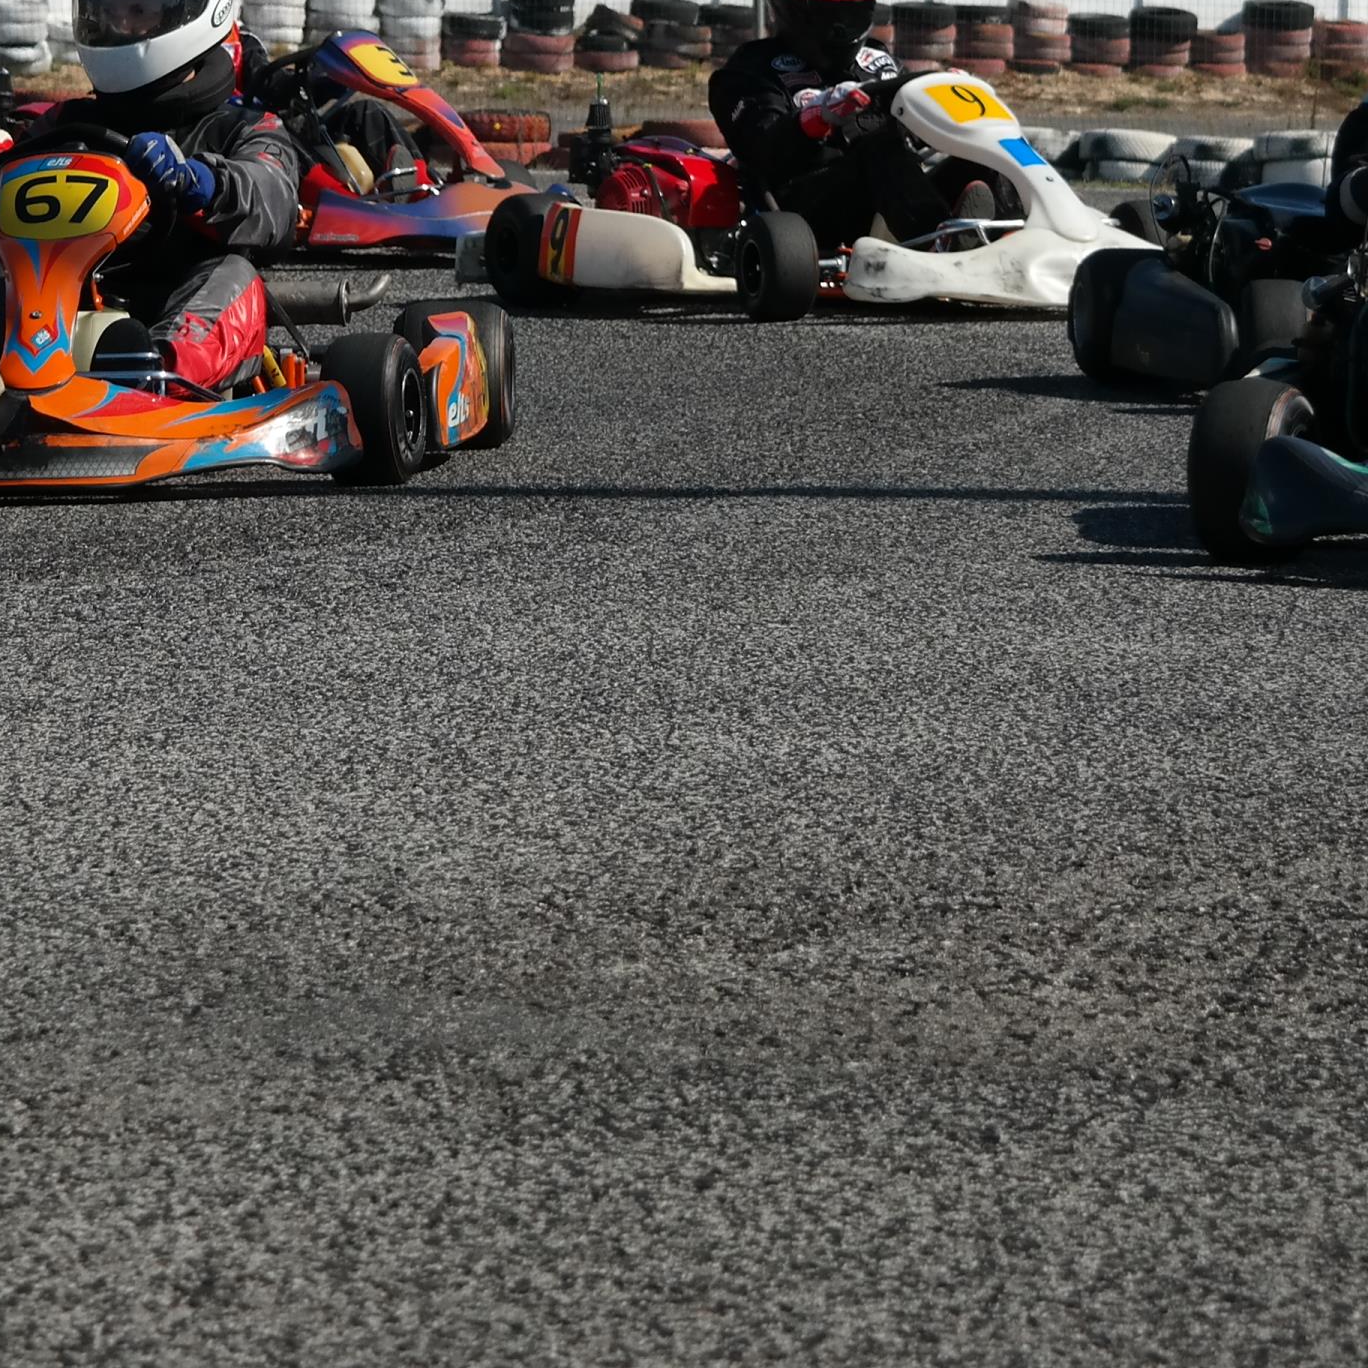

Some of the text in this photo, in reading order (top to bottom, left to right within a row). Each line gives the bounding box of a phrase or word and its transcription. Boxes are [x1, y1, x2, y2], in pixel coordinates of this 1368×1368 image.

[950, 85, 986, 117] 9
[14, 175, 109, 224] 67
[550, 207, 570, 275] 9
